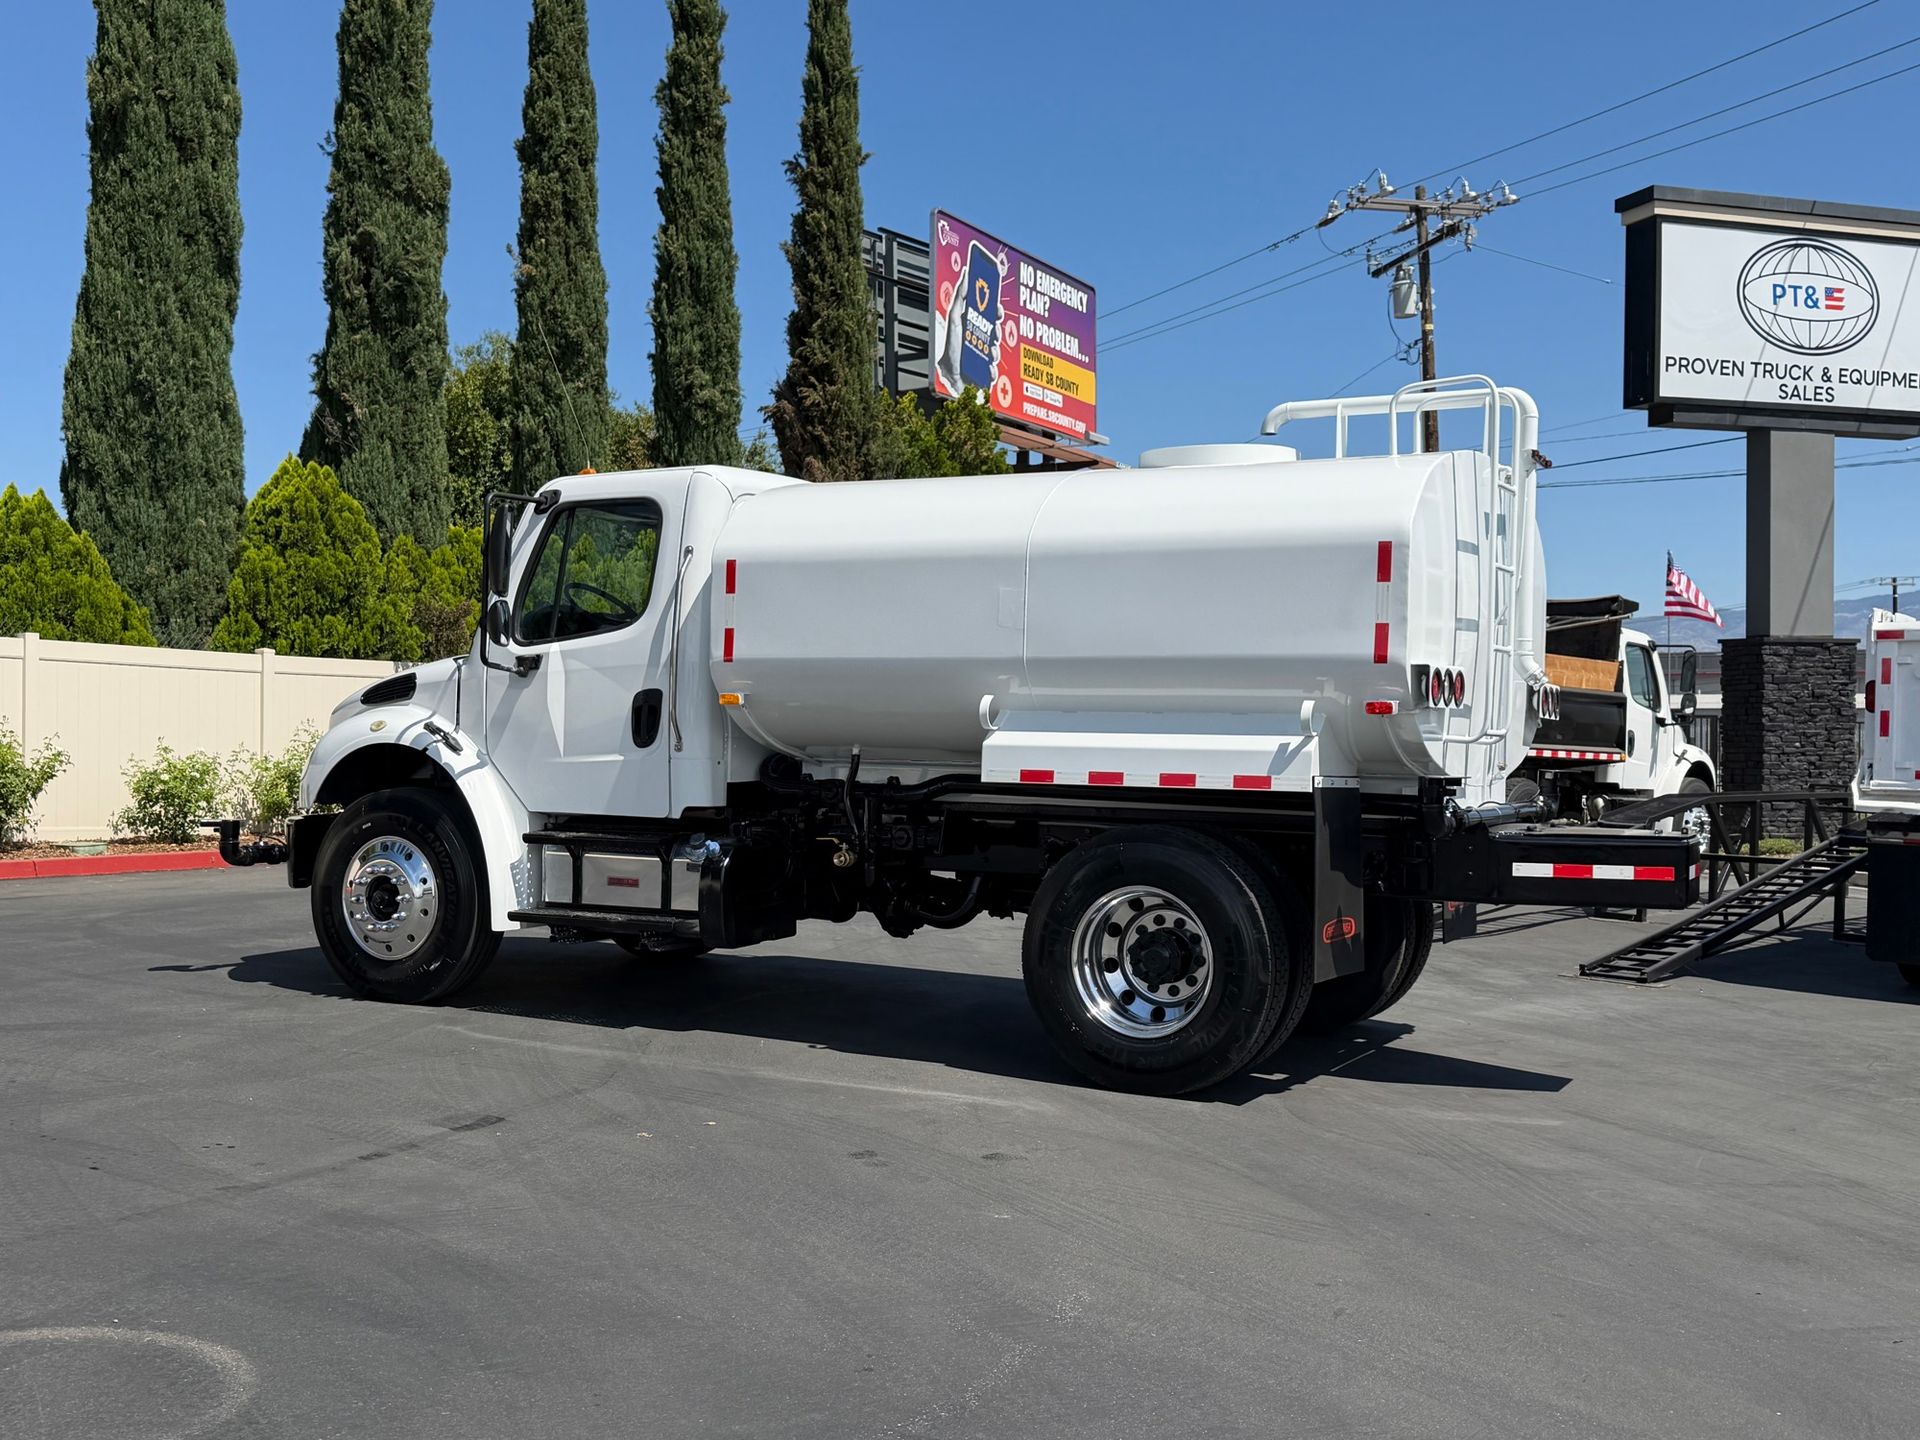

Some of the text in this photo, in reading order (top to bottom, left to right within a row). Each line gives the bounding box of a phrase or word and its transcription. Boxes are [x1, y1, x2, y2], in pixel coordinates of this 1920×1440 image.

[1020, 262, 1088, 313] NO EMERGENCY
[1020, 285, 1050, 318] PLAN?
[967, 306, 994, 336] READY
[1020, 314, 1090, 364] NO PROBLEM...
[1023, 347, 1054, 369] DOWNLOAD
[1665, 356, 1920, 389] PROVEN TRUCK & EQUIPME
[1023, 363, 1045, 382] READY
[1045, 371, 1054, 386] SB
[1055, 376, 1080, 396] COUNTY
[1778, 383, 1835, 403] SALES
